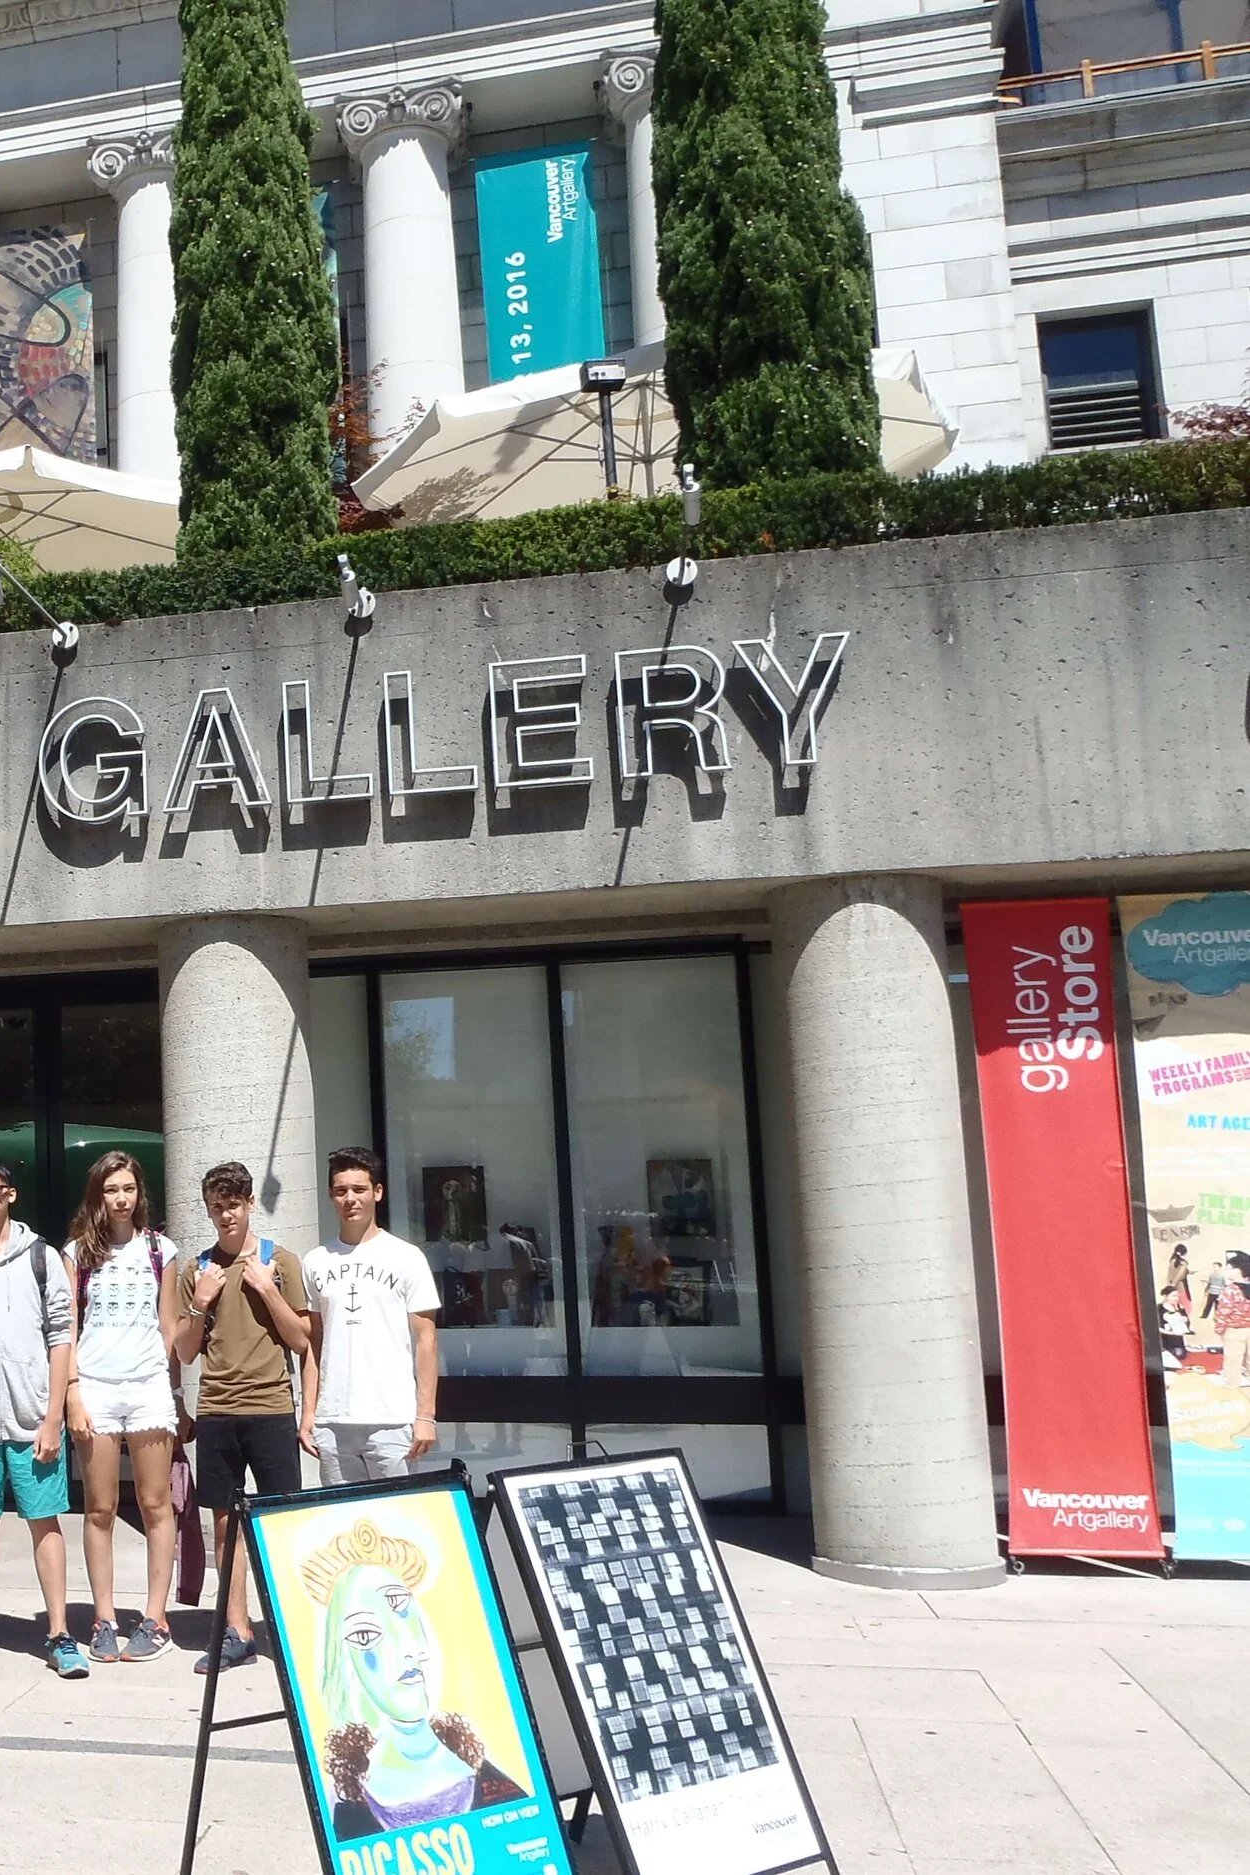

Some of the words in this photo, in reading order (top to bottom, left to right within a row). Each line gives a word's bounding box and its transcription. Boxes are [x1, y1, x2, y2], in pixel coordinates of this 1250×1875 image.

[546, 159, 563, 244] Vancouver
[561, 158, 577, 221] Artgallery
[505, 251, 530, 316] 2016
[510, 323, 533, 365] 13,
[37, 631, 851, 823] GALLERY
[1056, 924, 1104, 1062] Store
[1006, 945, 1069, 1093] gallery
[1148, 1060, 1202, 1082] WEEKLY
[1152, 1070, 1235, 1097] PROGRAMS
[1186, 1113, 1217, 1129] ART
[314, 1263, 399, 1293] CAPTAIN
[1022, 1488, 1149, 1510] Vancouver
[1052, 1508, 1150, 1533] Artgallery
[752, 1813, 799, 1835] Vancouver
